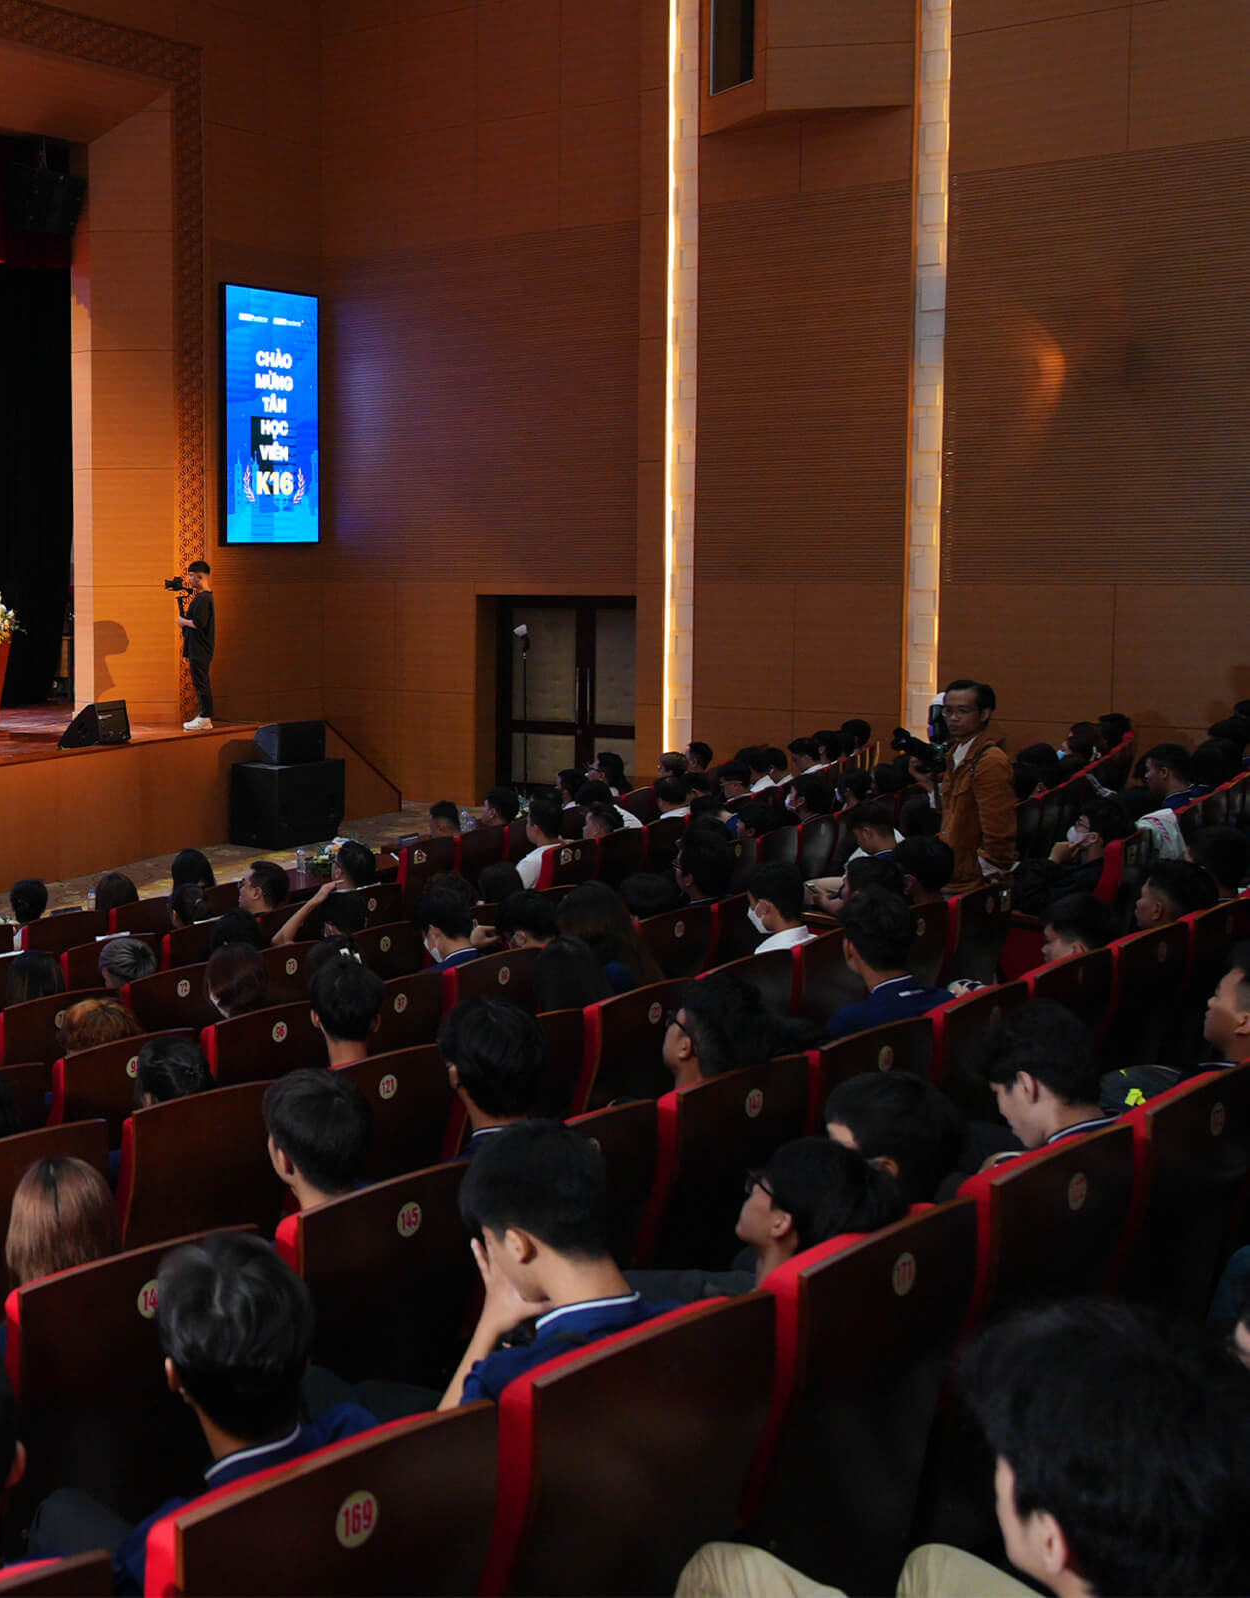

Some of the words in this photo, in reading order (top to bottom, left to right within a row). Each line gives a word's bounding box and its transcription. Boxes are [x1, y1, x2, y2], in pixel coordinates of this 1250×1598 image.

[255, 348, 293, 369] CHÀO
[260, 419, 289, 439] HỌC
[259, 440, 289, 461] VIÊN
[256, 471, 294, 495] K16
[381, 1078, 395, 1094] 121
[401, 1207, 418, 1232] 145
[143, 1288, 158, 1312] 14
[341, 1498, 373, 1537] 169
